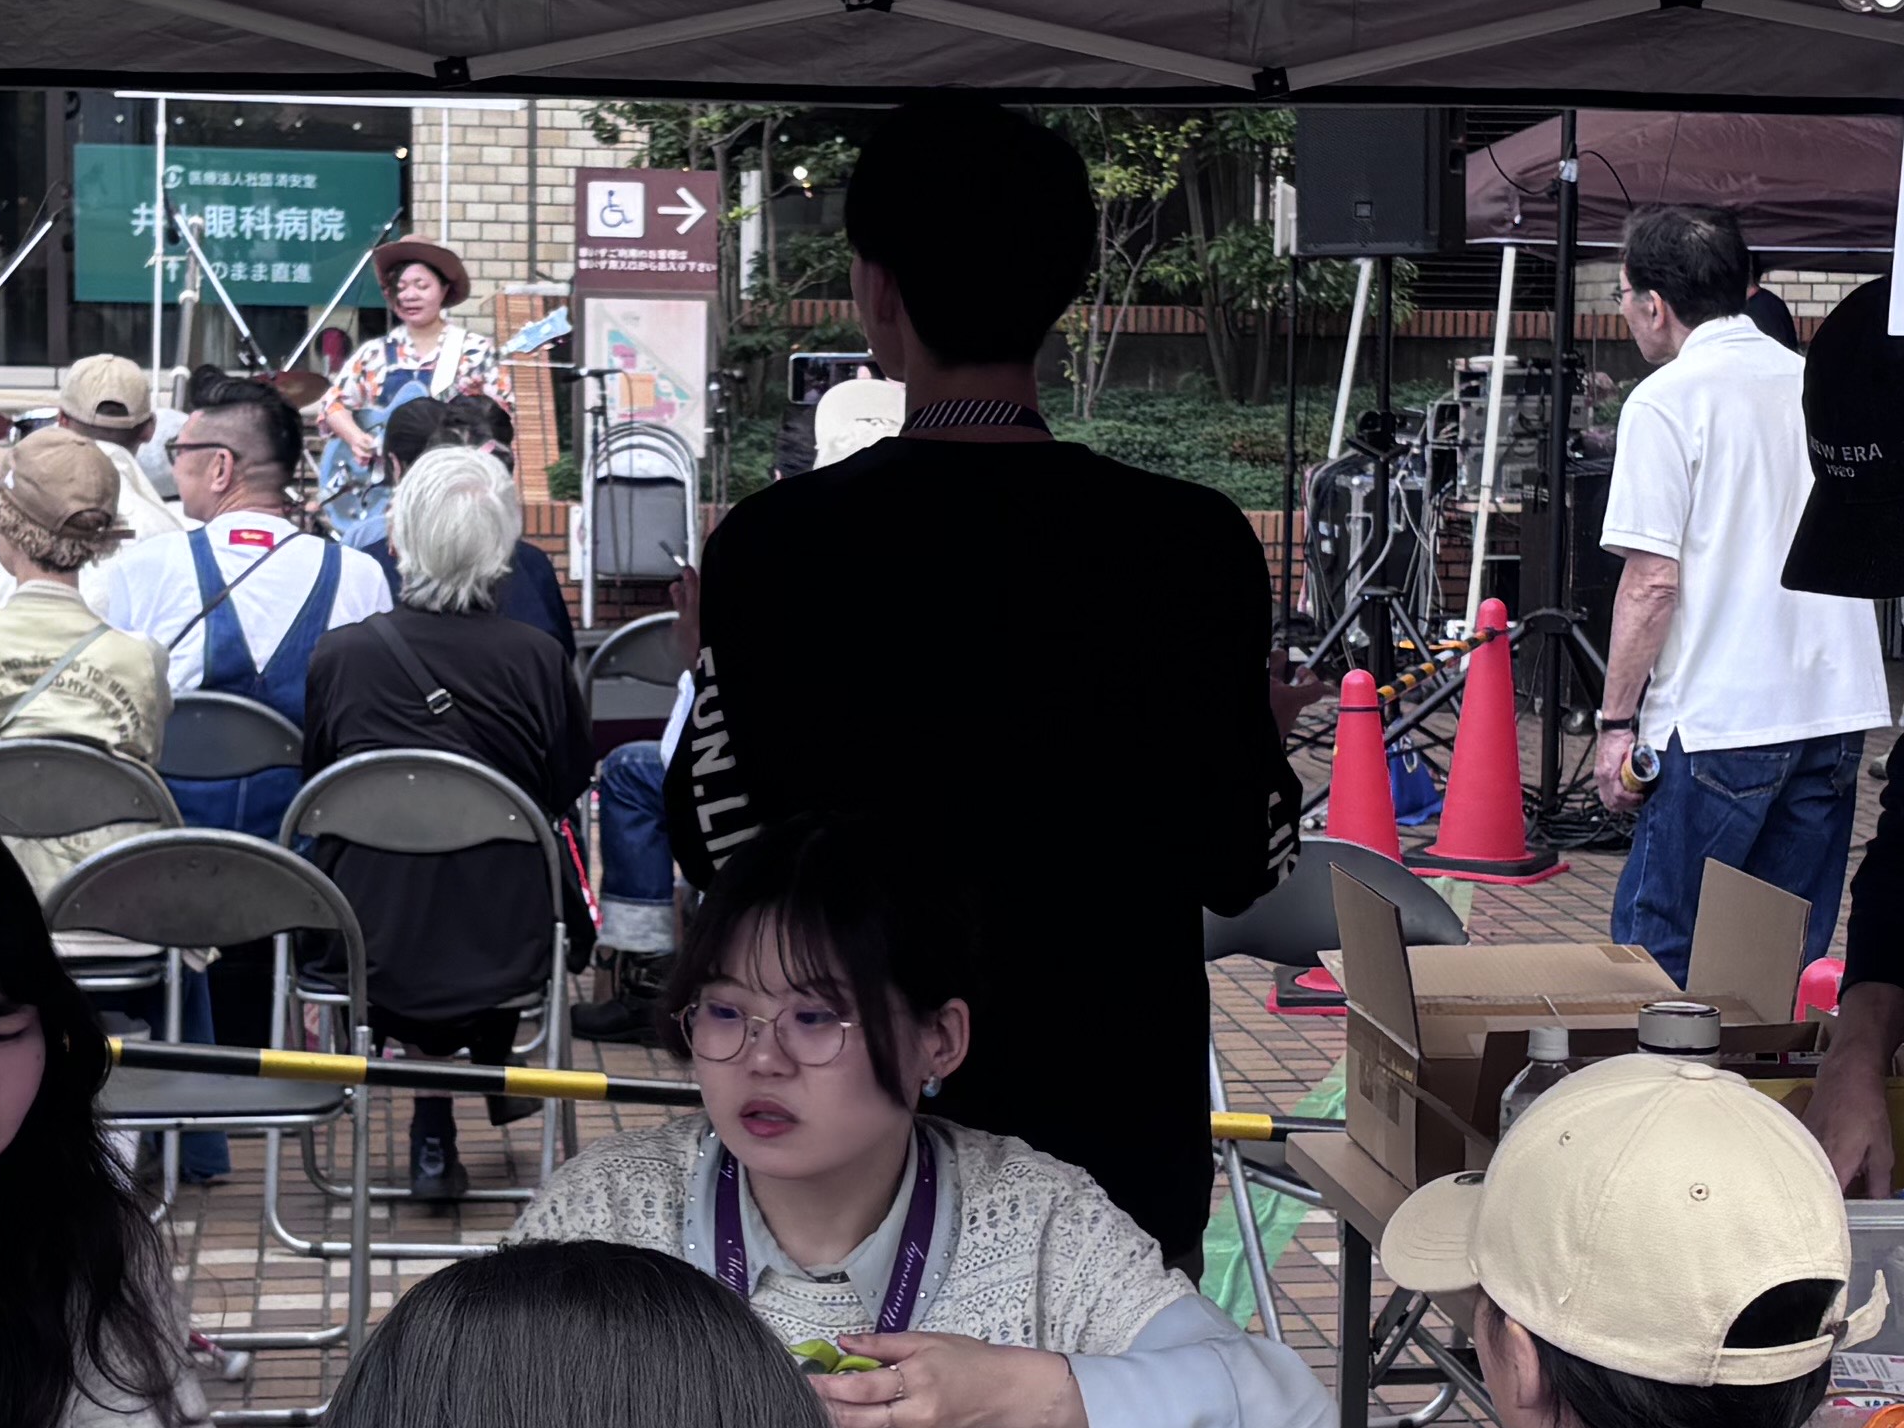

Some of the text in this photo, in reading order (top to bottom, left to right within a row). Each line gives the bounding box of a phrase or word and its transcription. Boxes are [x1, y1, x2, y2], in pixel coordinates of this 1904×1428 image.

[203, 260, 313, 283] のまま直進
[1841, 443, 1883, 463] ERA
[691, 646, 764, 871] UN.LI
